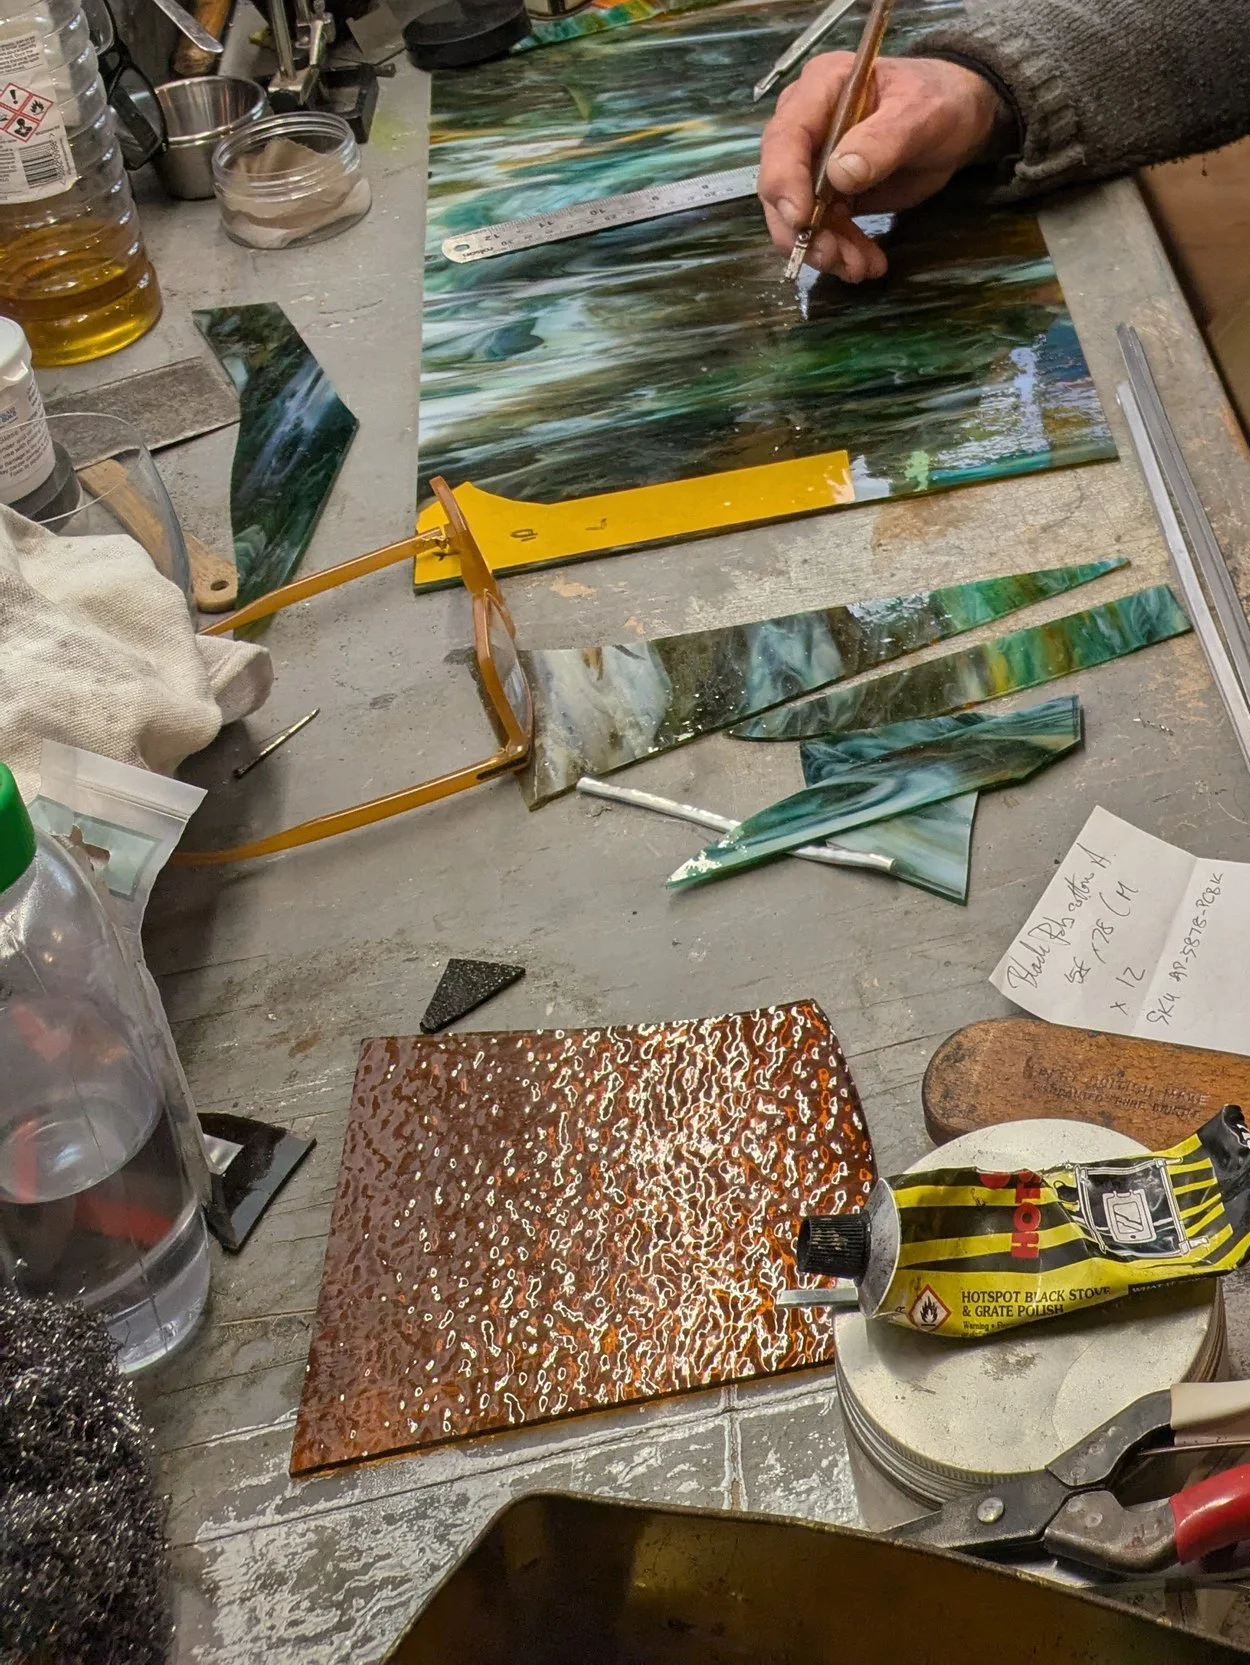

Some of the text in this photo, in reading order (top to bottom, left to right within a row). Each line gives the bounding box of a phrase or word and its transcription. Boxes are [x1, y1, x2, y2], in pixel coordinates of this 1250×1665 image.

[1116, 967, 1146, 989] 12
[961, 1286, 1112, 1304] HOTSPOT BLACK STOVE
[962, 1303, 1065, 1317] & GRATE POLISH
[963, 1321, 990, 1332] Warning
